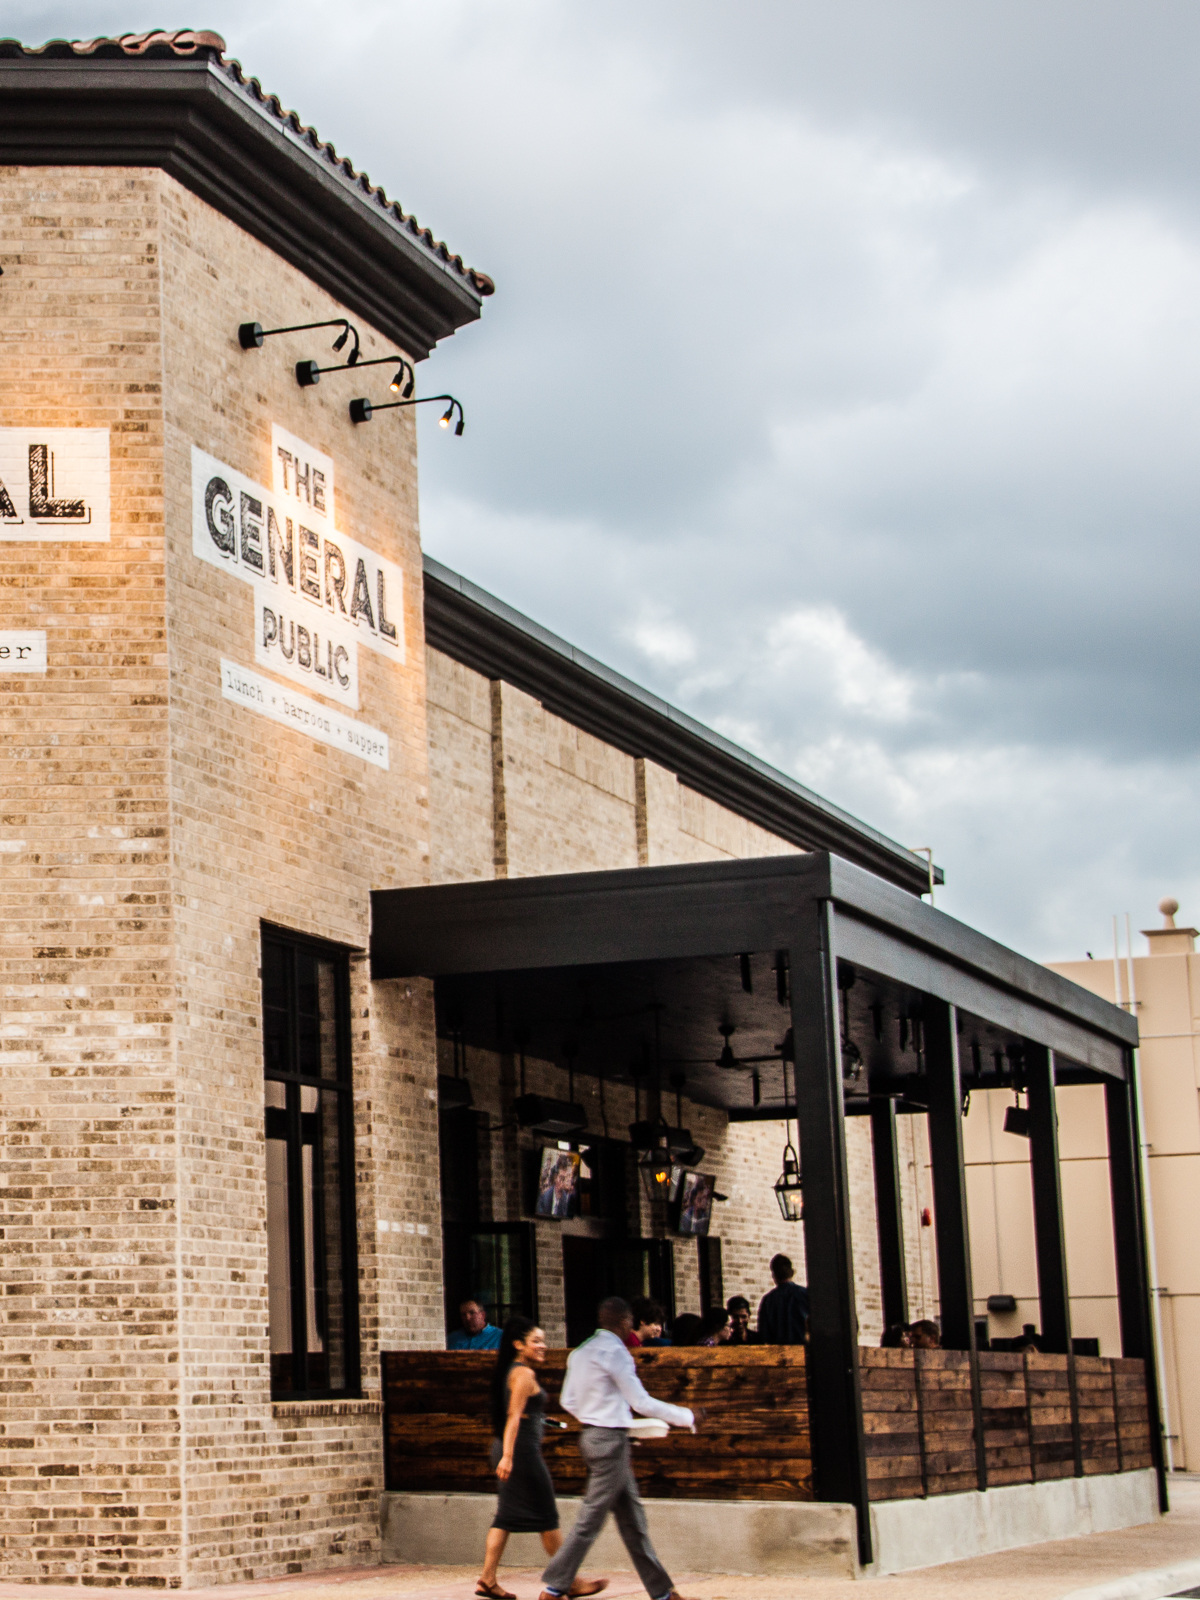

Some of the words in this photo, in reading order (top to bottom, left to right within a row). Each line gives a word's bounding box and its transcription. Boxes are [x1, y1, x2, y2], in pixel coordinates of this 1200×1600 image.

[277, 446, 327, 516] THE
[204, 476, 399, 646] GENERAL
[263, 606, 351, 691] PUBLIC
[227, 670, 263, 703] lunch
[284, 695, 331, 733] barroom
[347, 730, 385, 757] supper
